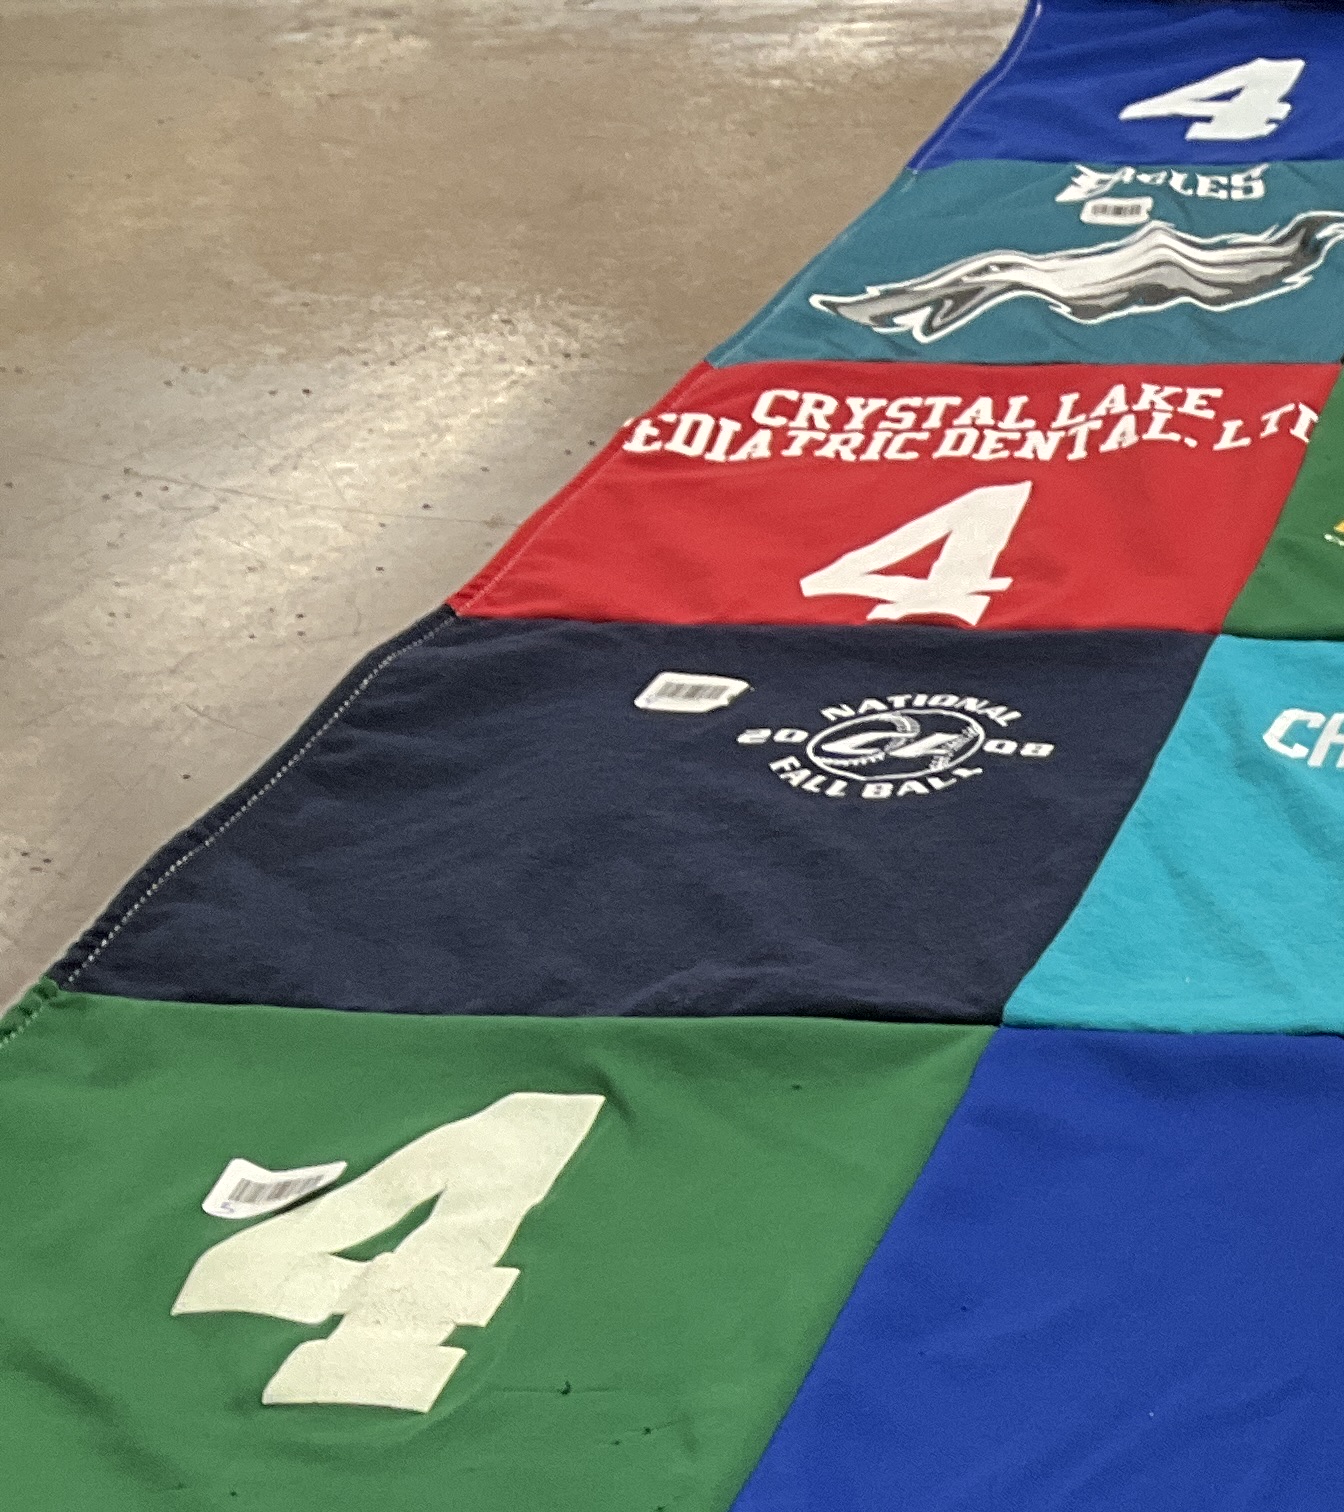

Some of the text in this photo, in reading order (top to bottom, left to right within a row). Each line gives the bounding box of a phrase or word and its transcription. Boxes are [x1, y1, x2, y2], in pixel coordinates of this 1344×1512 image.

[1119, 58, 1304, 140] 4
[752, 383, 1223, 430] CRYSTAL LAKE
[622, 411, 930, 462] EDIATRIC
[800, 480, 1032, 626] 4
[821, 693, 1021, 726] NATIONAL
[770, 755, 983, 799] FALL BALL
[171, 1092, 605, 1413] 4
